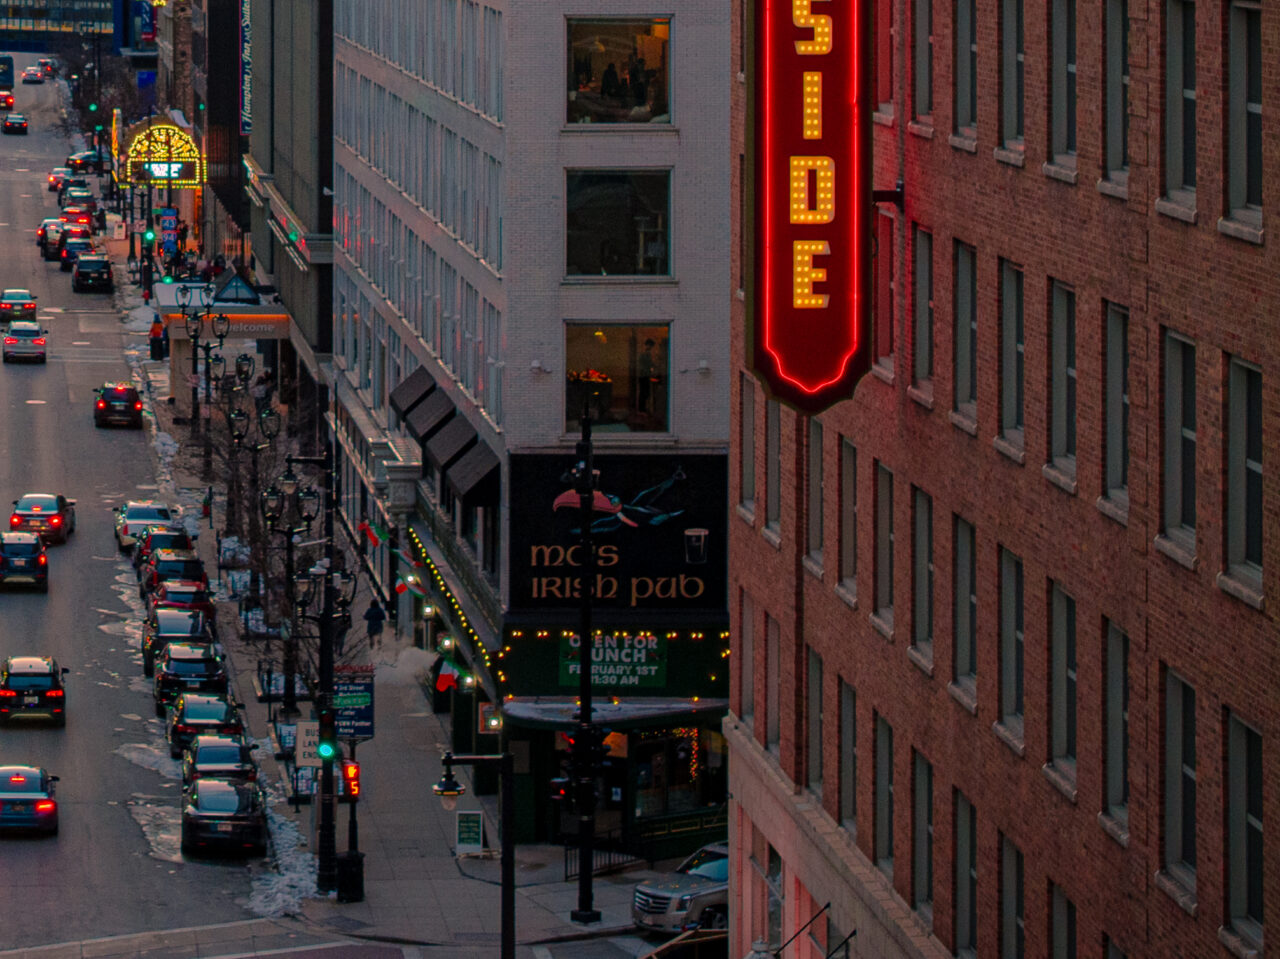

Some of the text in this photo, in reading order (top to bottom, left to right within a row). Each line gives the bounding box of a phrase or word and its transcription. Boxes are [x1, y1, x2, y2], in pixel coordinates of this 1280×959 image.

[631, 574, 705, 607] pub
[569, 634, 658, 649] OEN FOR
[589, 648, 647, 663] UNCH
[619, 675, 639, 685] AM
[351, 781, 359, 795] 5
